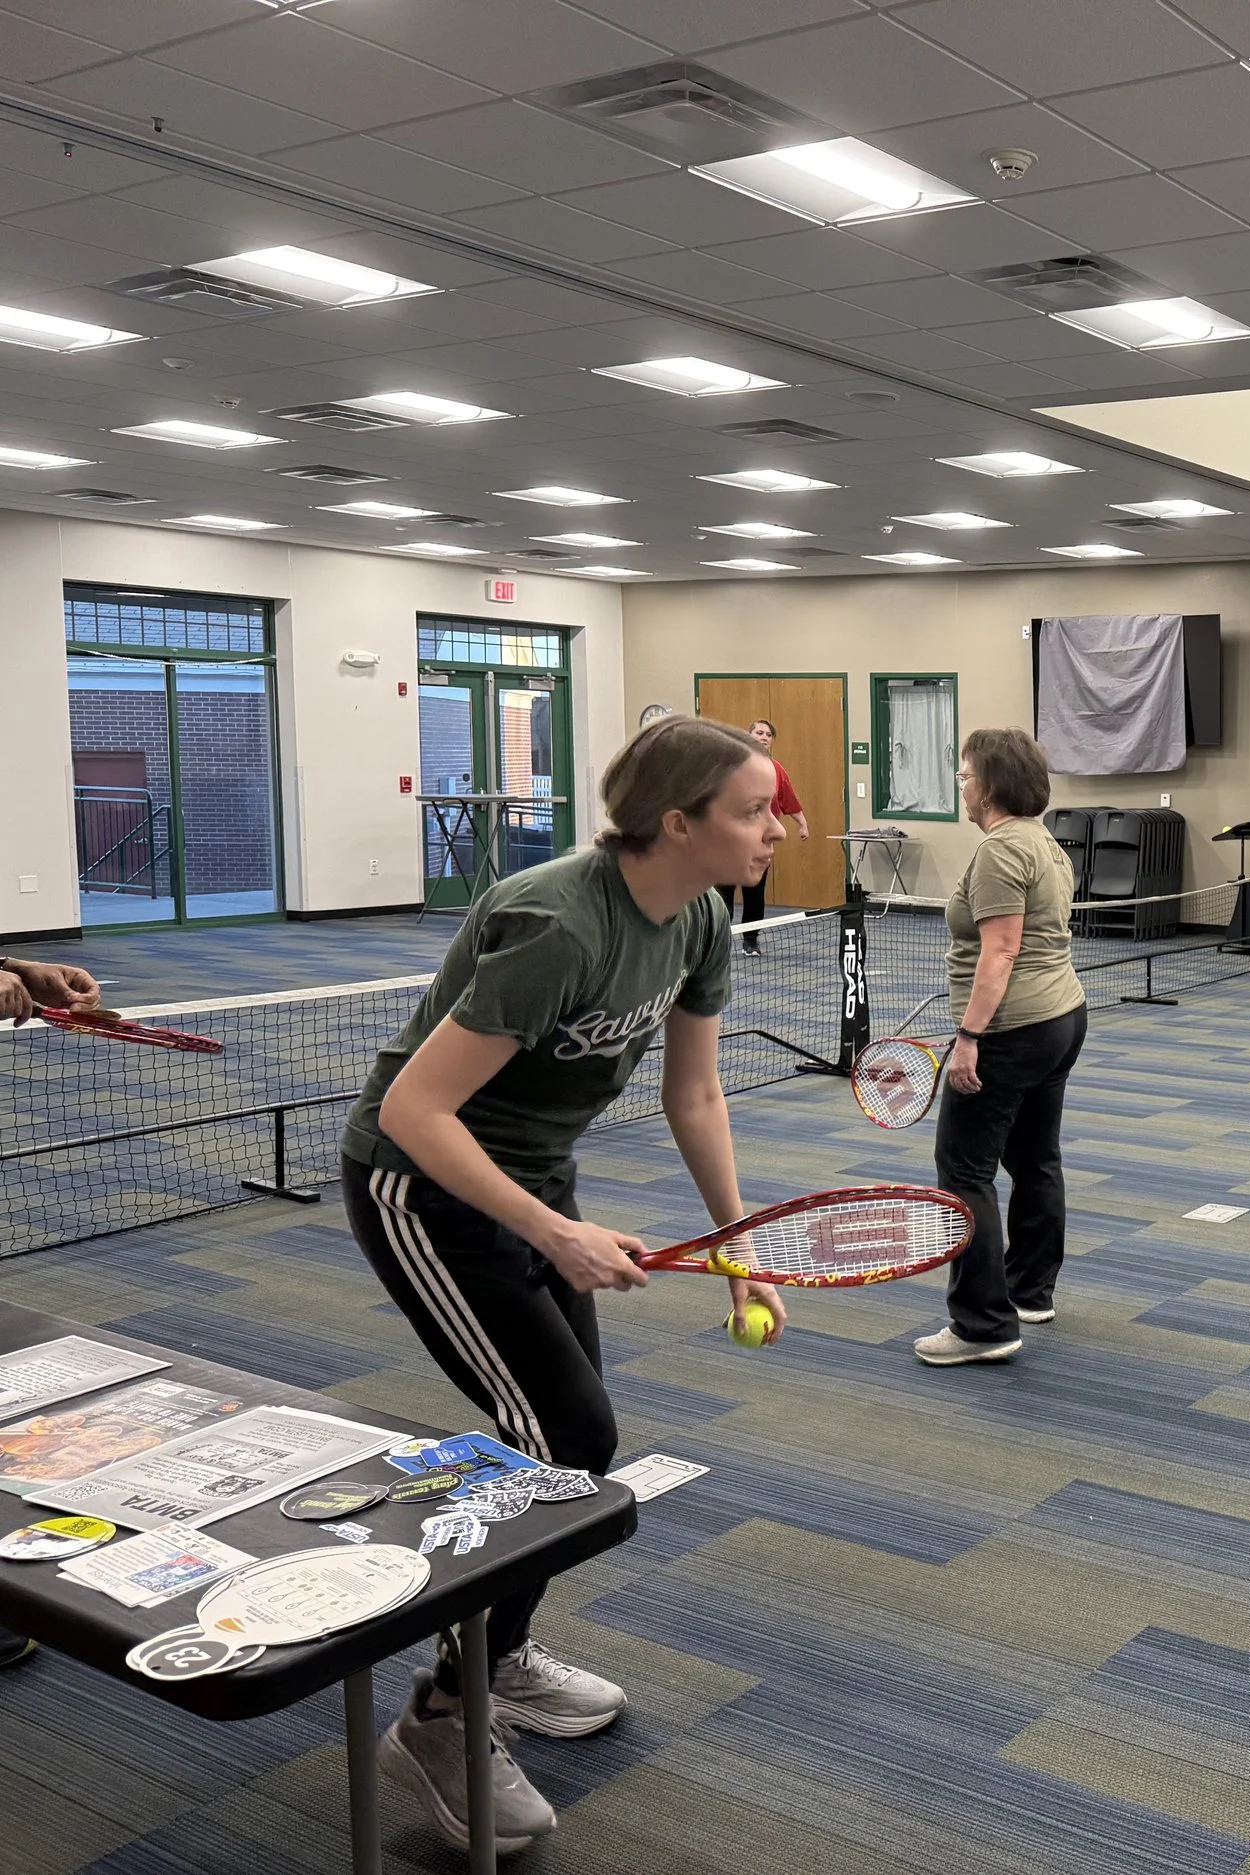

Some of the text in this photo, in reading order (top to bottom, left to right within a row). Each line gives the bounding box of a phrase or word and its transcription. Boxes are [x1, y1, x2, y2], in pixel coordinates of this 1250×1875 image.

[495, 581, 514, 600] EXIT
[844, 929, 857, 1019] HEAD
[121, 1495, 201, 1521] BMTA
[463, 1506, 497, 1516] USTA
[421, 1532, 440, 1553] USTA
[456, 1532, 474, 1553] USTA
[164, 1646, 212, 1668] 23
